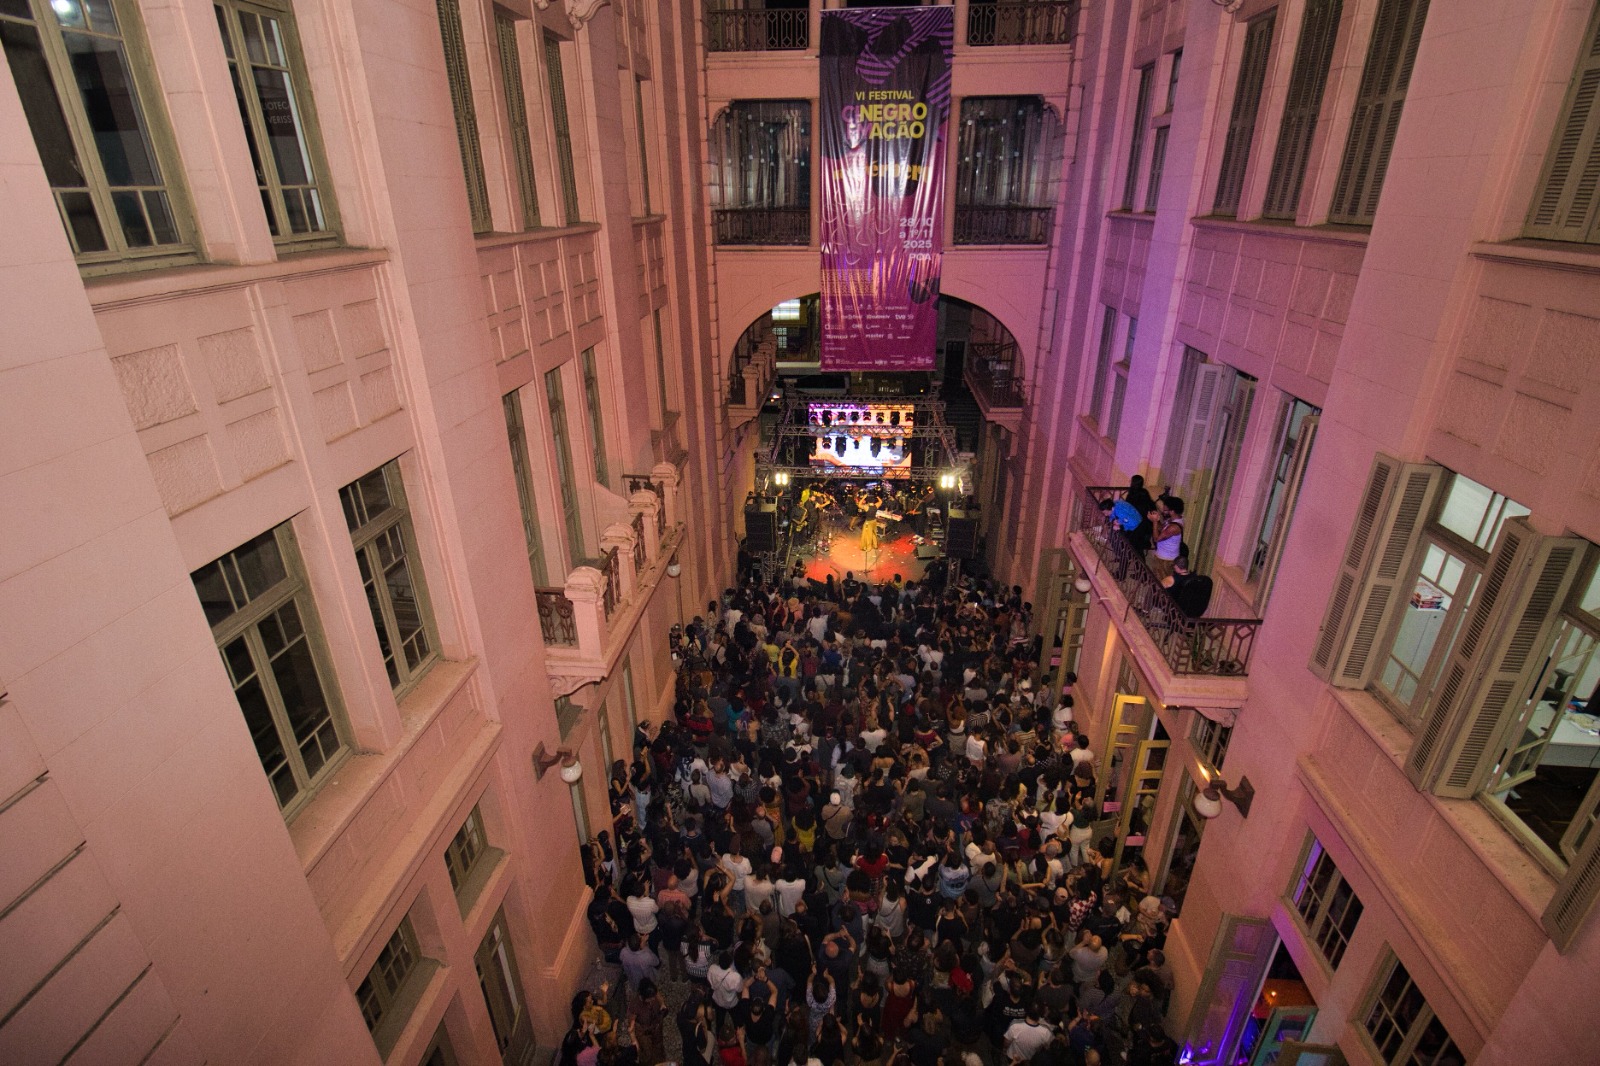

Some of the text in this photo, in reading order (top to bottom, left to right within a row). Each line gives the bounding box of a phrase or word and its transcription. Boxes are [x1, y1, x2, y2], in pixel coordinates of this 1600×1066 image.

[856, 90, 914, 100] VI FESTIVAL
[869, 121, 925, 141] AÇÃO
[903, 240, 932, 249] 2025
